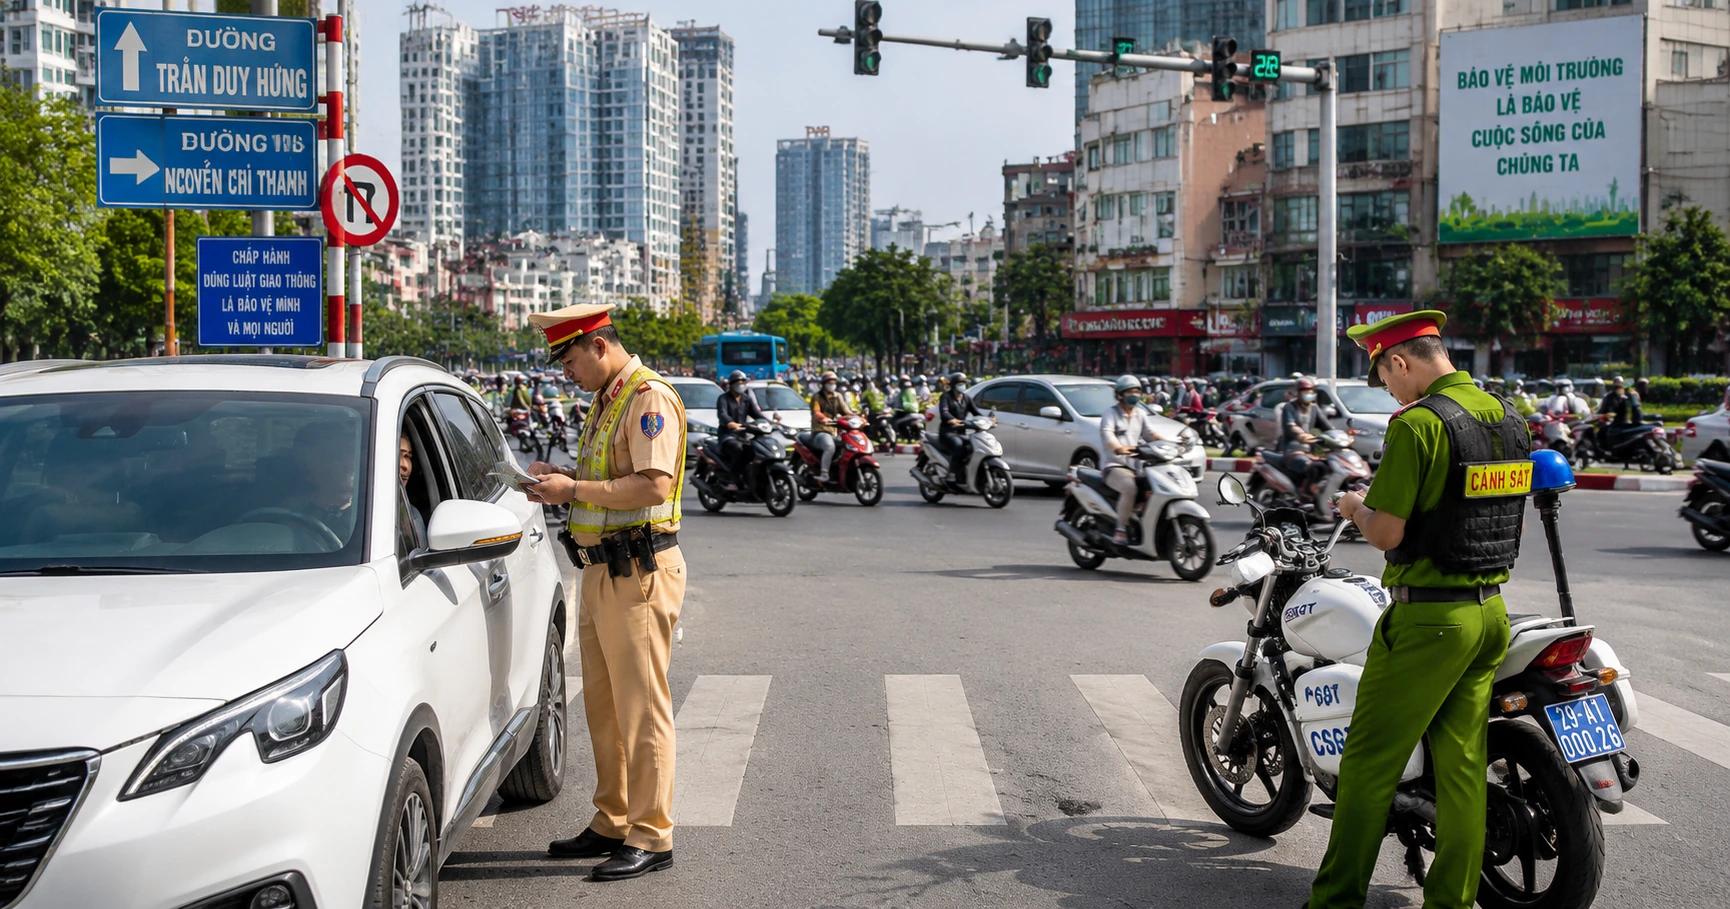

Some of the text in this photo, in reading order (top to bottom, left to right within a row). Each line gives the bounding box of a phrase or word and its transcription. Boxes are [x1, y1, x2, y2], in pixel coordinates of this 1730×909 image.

[213, 65, 250, 96] DUY
[1558, 152, 1580, 172] TA
[259, 273, 282, 288] GIAO
[1555, 698, 1605, 730] 29-A1
[1560, 724, 1622, 758] 000.26
